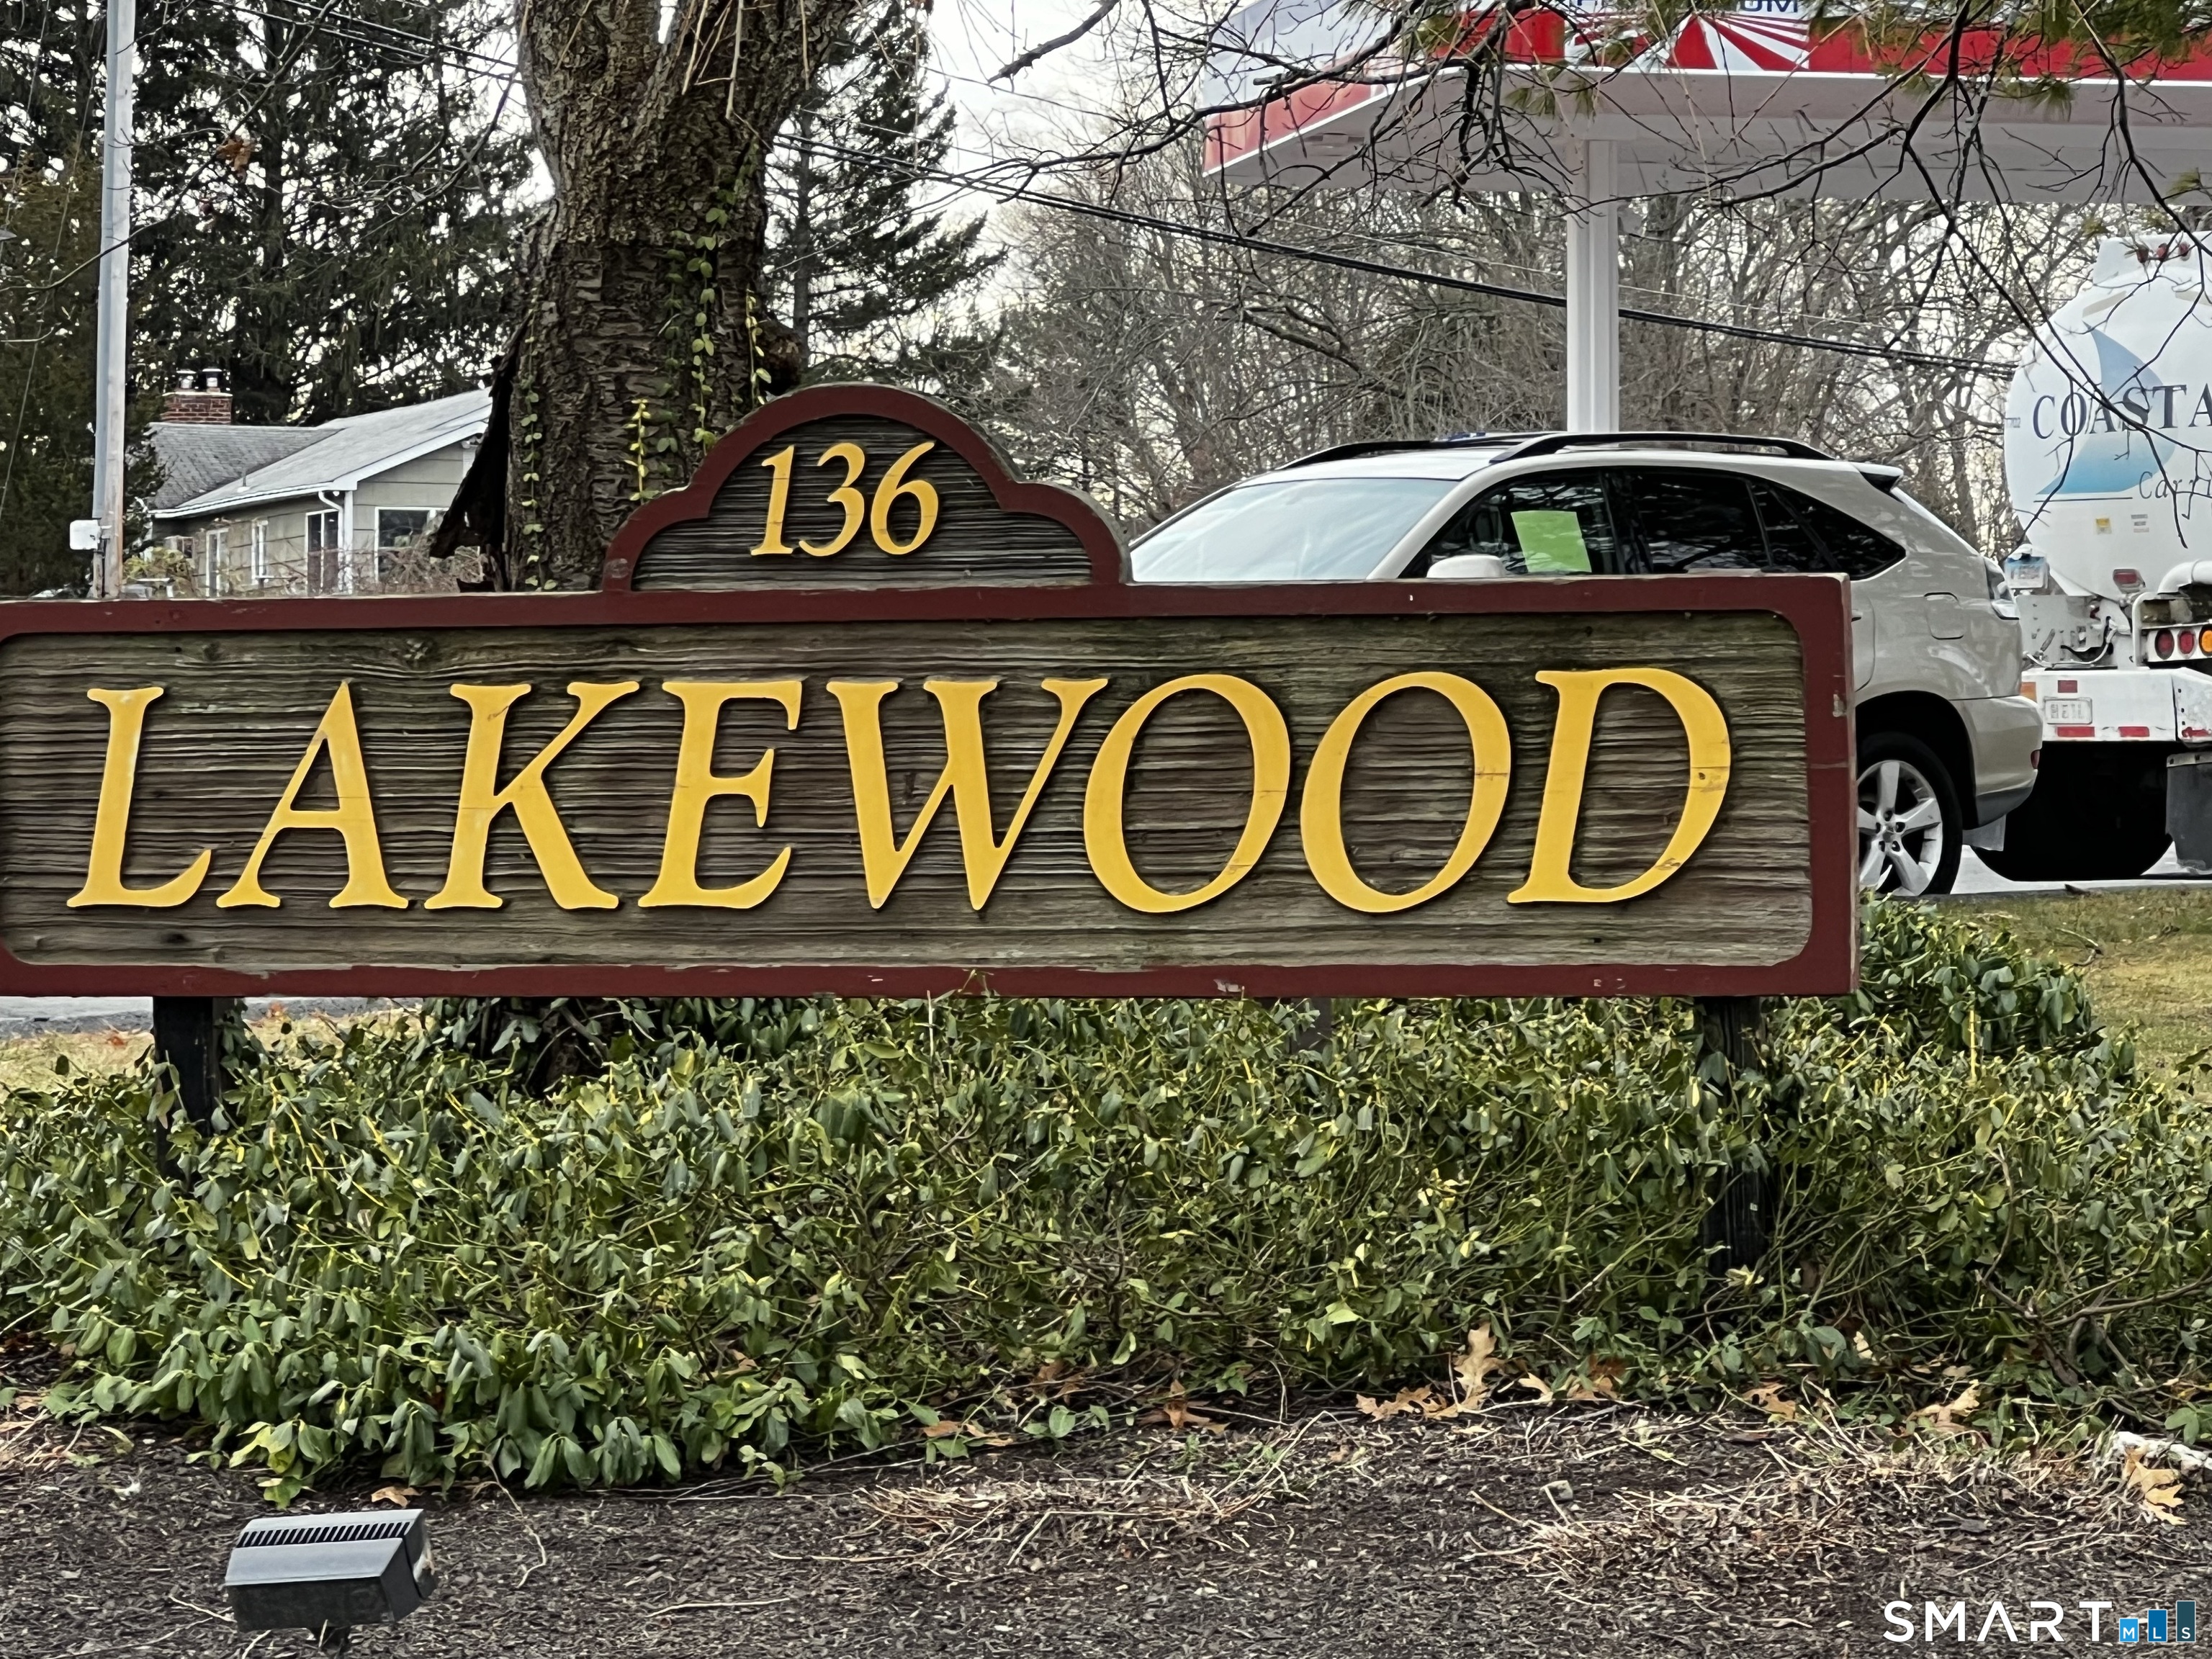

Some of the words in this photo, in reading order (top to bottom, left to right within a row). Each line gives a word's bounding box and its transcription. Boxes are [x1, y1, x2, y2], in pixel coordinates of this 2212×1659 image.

[2033, 383, 2212, 439] COASTA
[751, 442, 938, 557] 136
[67, 667, 1732, 912] LAKEWOOD
